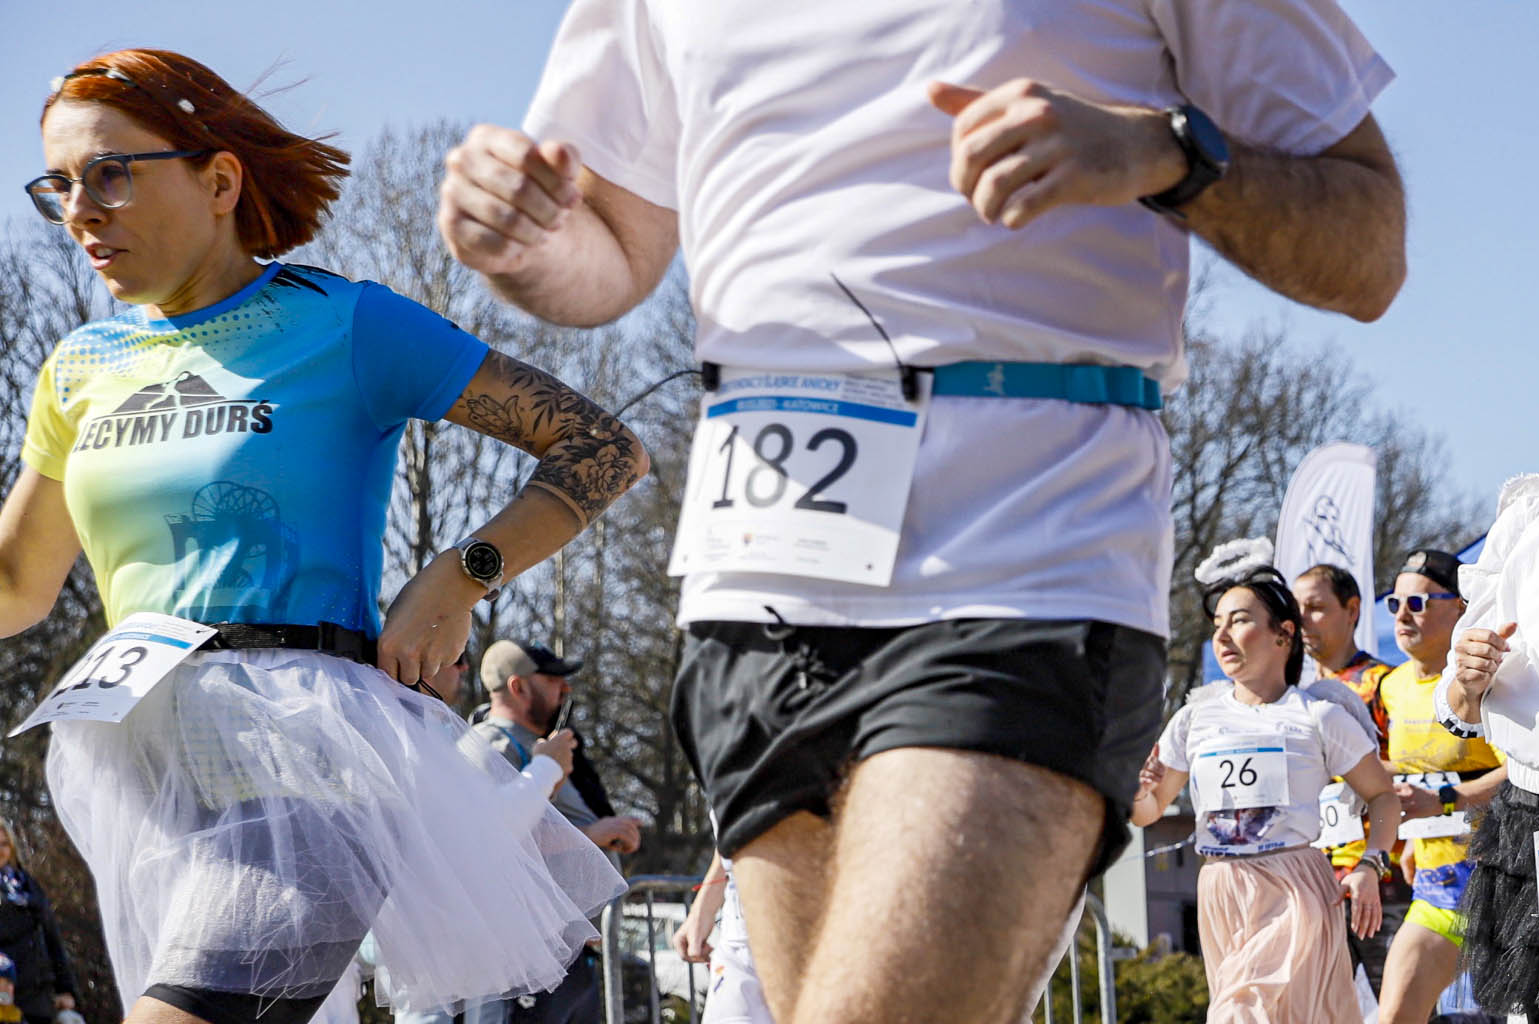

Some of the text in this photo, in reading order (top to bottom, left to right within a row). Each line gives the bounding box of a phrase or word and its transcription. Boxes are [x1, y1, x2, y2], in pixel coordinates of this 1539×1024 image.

[182, 400, 273, 439] DURŚ
[712, 423, 858, 514] 182
[1220, 757, 1257, 788] 26
